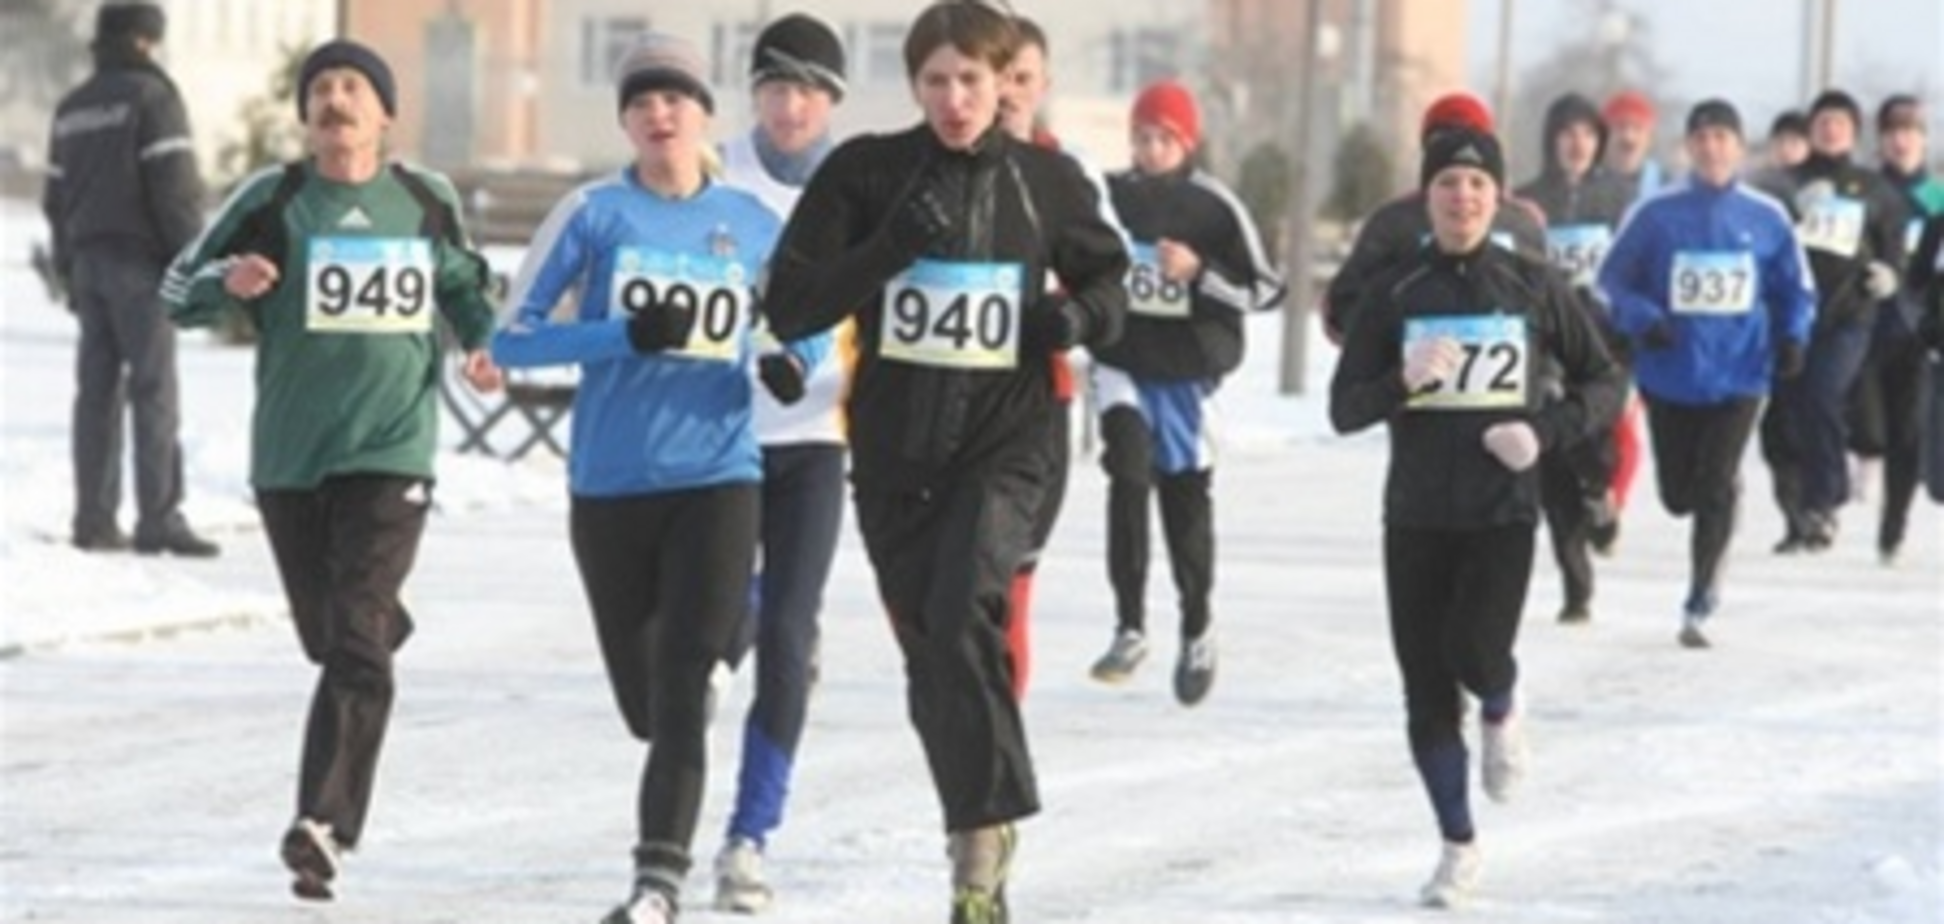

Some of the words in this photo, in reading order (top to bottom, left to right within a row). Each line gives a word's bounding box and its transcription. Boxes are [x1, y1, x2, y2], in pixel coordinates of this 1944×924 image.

[318, 264, 424, 317] 949
[1680, 268, 1747, 304] 937
[894, 288, 1011, 351] 940
[1418, 342, 1519, 393] 72
